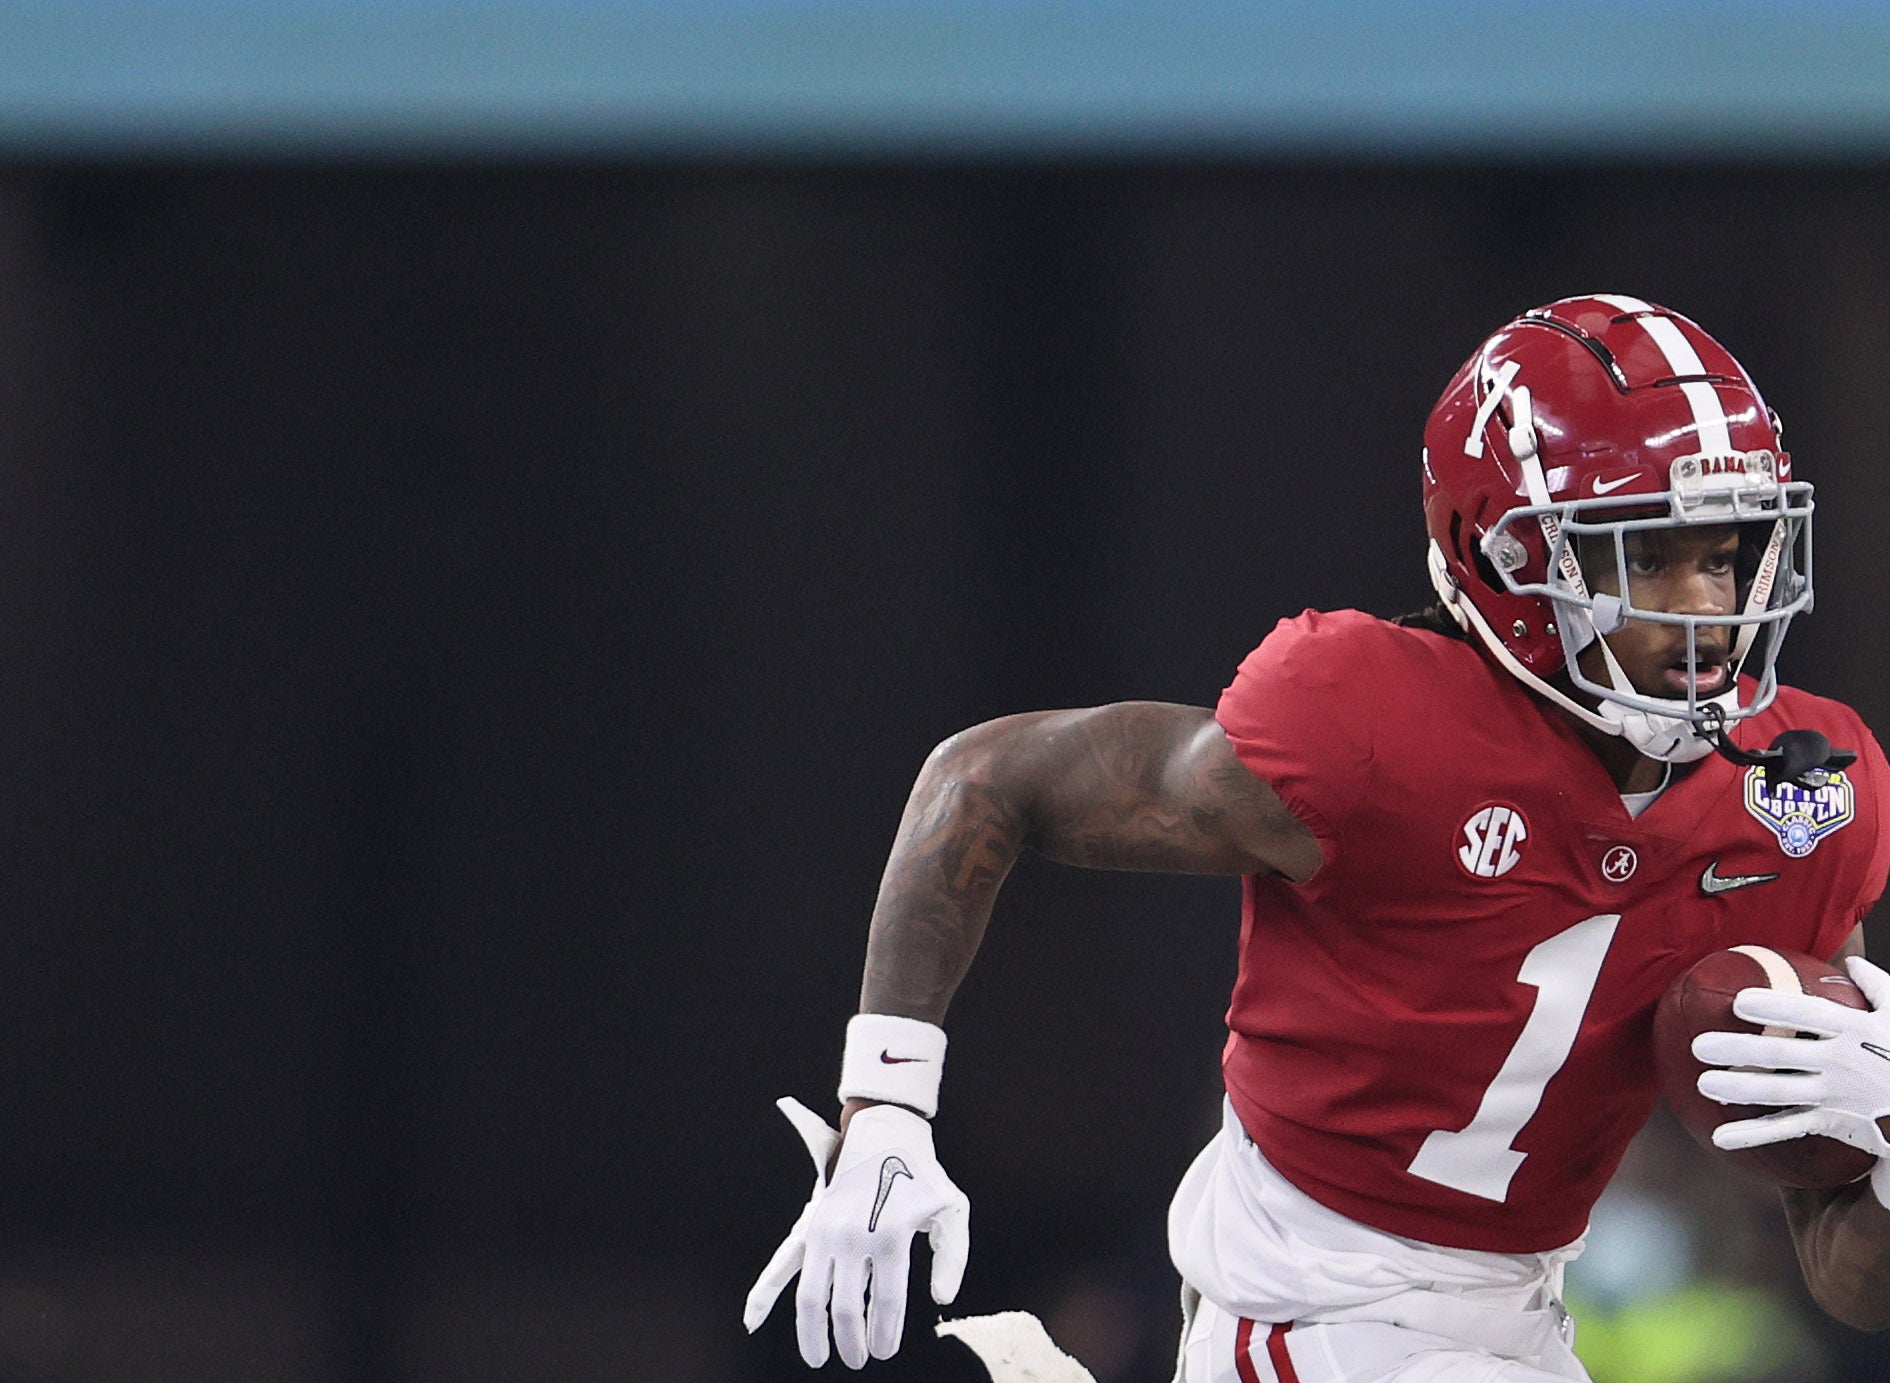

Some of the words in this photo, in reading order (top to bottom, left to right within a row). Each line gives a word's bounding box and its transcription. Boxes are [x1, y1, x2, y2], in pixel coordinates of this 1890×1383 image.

[1700, 456, 1746, 476] BAMA
[1541, 515, 1578, 579] CRISON
[1753, 541, 1780, 605] CRIMSON
[1458, 806, 1527, 878] SEC
[1770, 798, 1829, 822] BOWL
[1407, 914, 1621, 1203] 1
